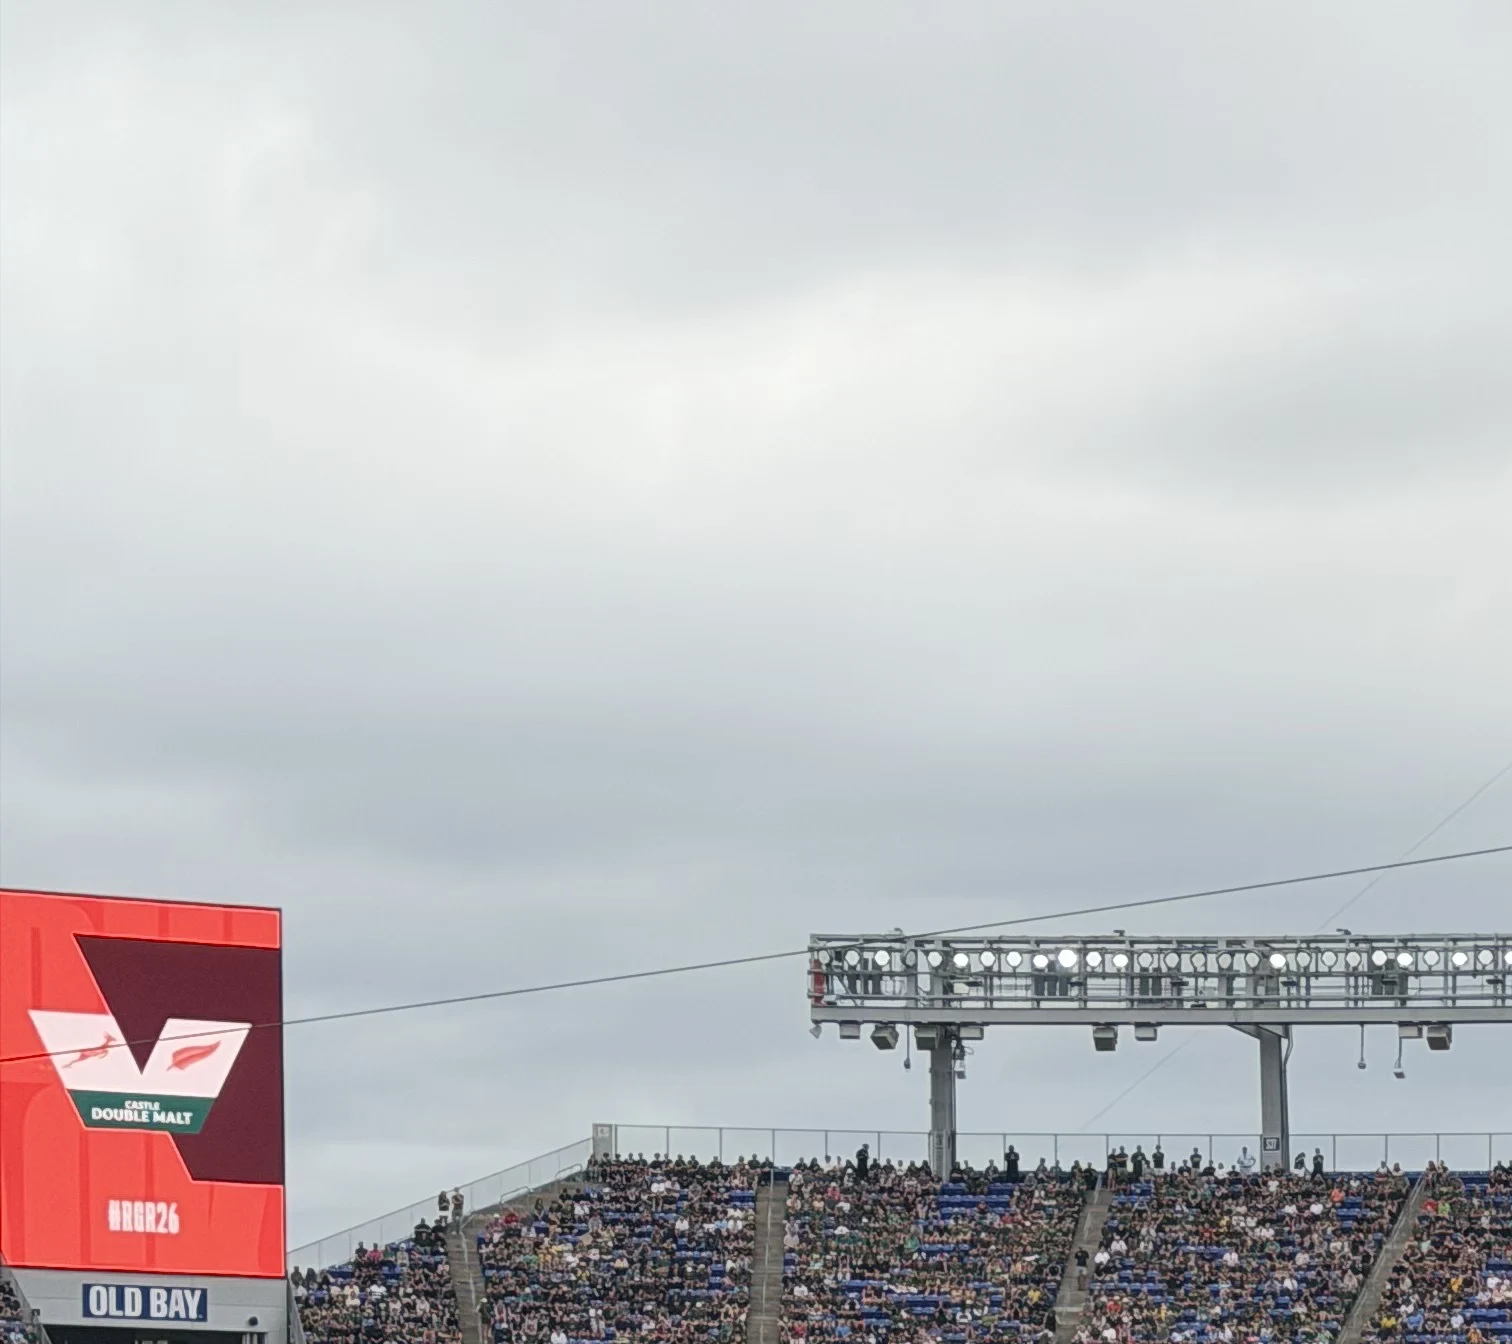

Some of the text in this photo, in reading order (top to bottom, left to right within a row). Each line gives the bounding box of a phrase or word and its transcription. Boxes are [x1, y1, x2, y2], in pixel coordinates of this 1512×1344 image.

[91, 1108, 193, 1125] DOUBLE MALT
[124, 1100, 160, 1111] CASTLE
[108, 1199, 180, 1234] #RGR26
[89, 1285, 143, 1317] OLD
